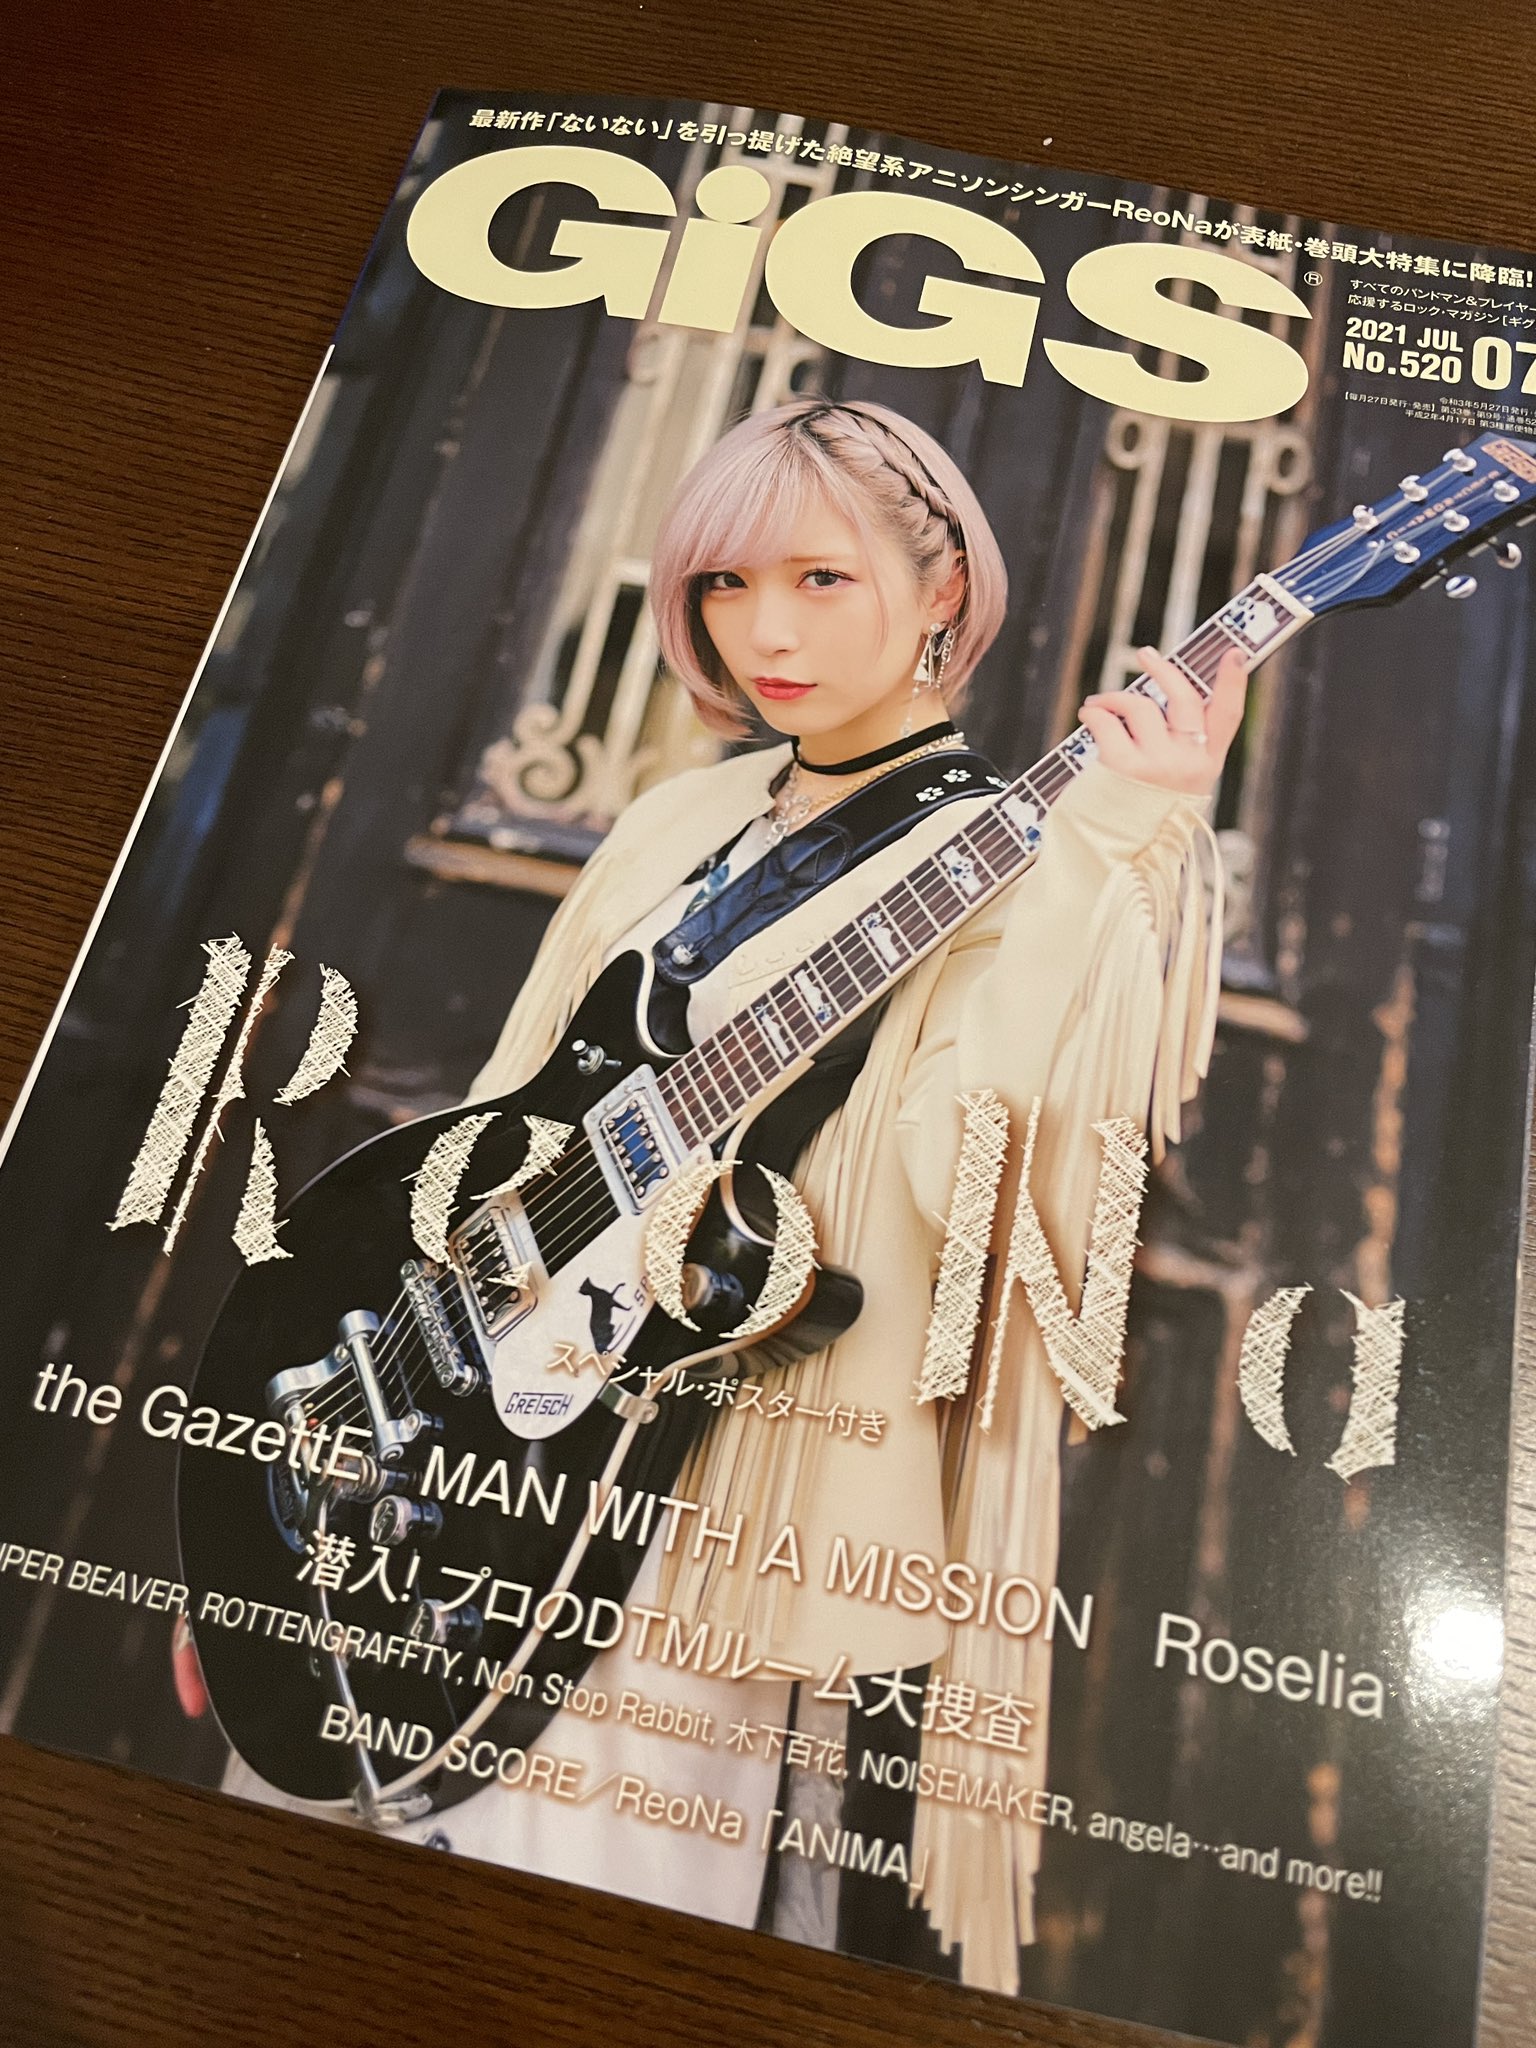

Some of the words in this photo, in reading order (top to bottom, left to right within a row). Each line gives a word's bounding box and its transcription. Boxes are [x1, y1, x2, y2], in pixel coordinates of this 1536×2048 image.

[407, 145, 1313, 422] GiGS
[1342, 341, 1462, 384] No.520
[1346, 317, 1407, 345] 2021
[1417, 328, 1464, 352] JUL
[546, 1341, 888, 1442] スペシャル・ポスター付き
[32, 1362, 122, 1424] the
[142, 1384, 374, 1482] GazettE
[420, 1445, 569, 1526] MAN
[587, 1480, 744, 1566] WITH
[759, 1524, 802, 1582] A
[826, 1537, 1095, 1650] MISSION
[1154, 1612, 1385, 1719] Roselia
[0, 1543, 64, 1585] PER
[473, 1656, 534, 1699] Non
[541, 1673, 608, 1718] Stop
[617, 1691, 715, 1746] Rabbit,
[860, 1749, 1079, 1837] NOISEMAKER,
[320, 1705, 433, 1763] BAND
